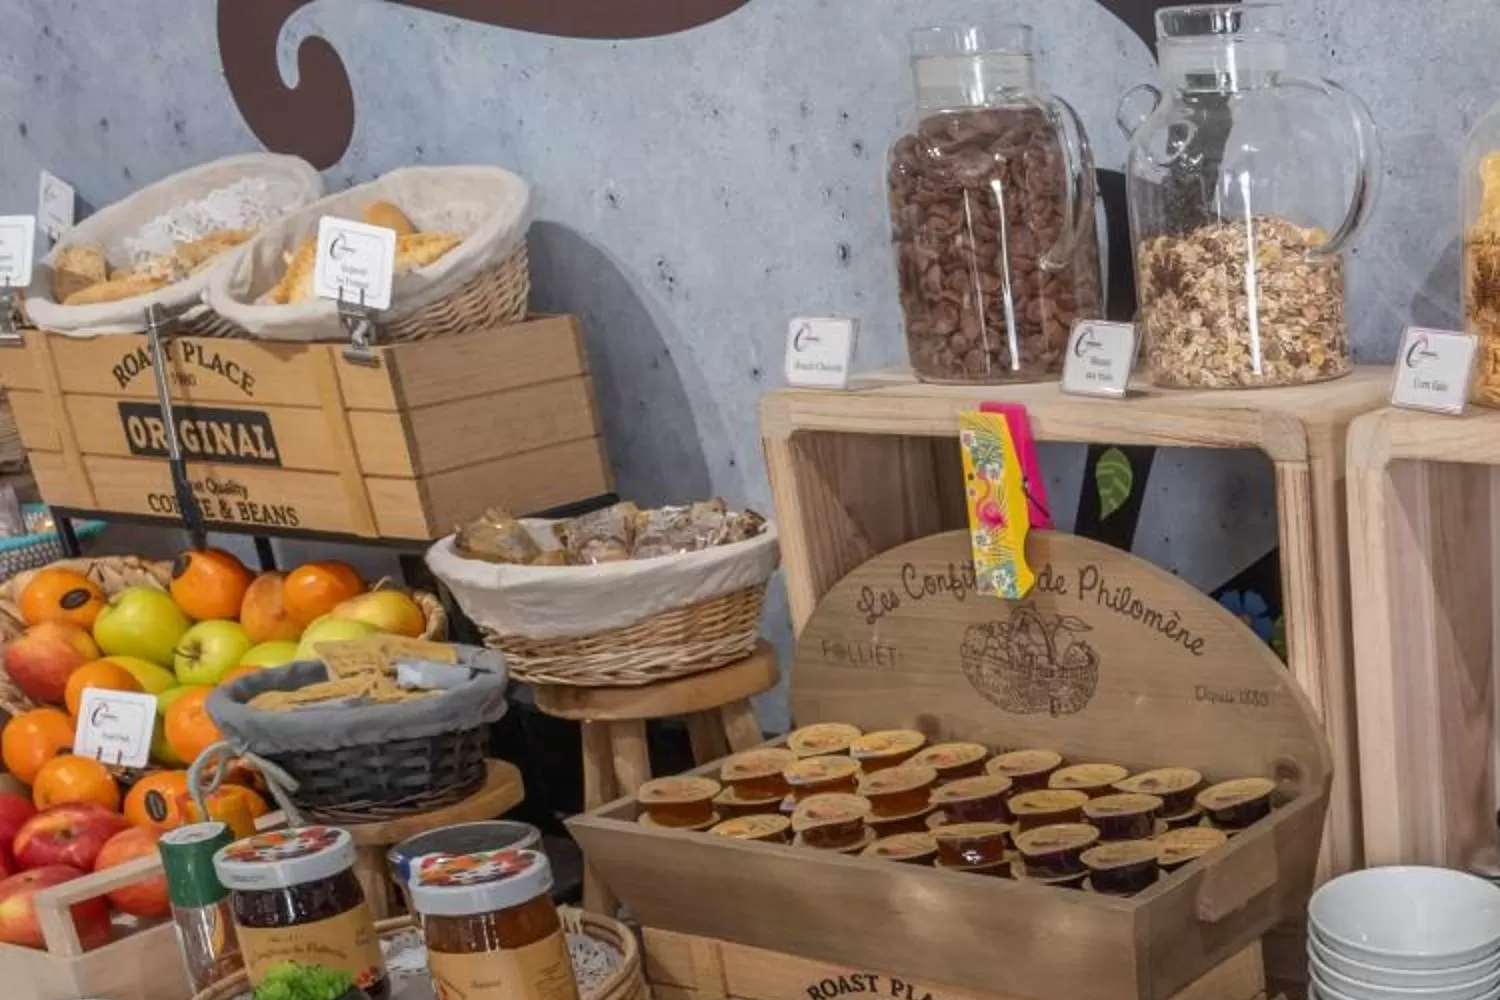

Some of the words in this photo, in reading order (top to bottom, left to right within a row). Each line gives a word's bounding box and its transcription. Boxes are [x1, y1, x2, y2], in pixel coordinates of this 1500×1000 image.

[112, 339, 173, 389] ROAT
[181, 340, 257, 397] PLACE
[127, 414, 277, 460] ORGINAL
[218, 499, 233, 520] &
[236, 501, 299, 527] BEANS
[1036, 563, 1068, 595] de
[1078, 563, 1207, 657] Philomène
